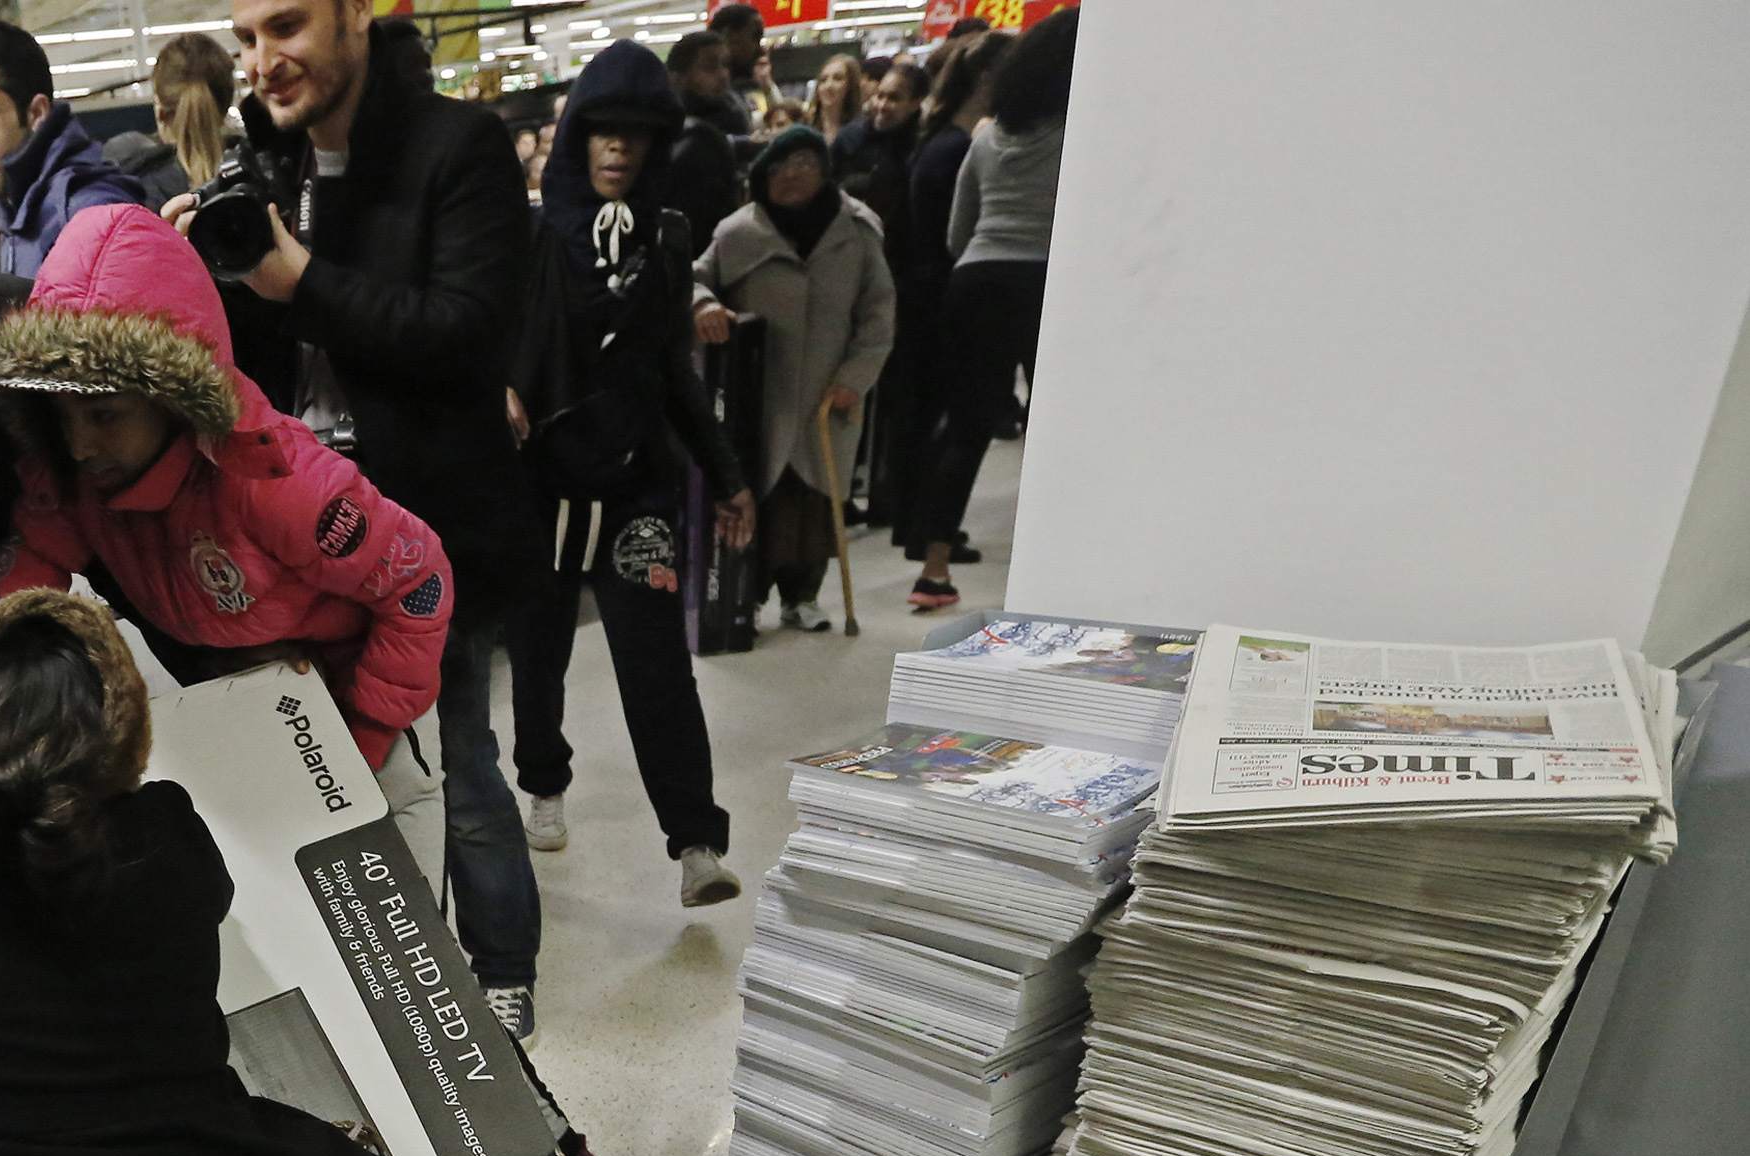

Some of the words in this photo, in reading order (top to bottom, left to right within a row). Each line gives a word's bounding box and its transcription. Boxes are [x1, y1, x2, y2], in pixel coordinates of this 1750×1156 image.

[298, 178, 313, 231] Canon
[1319, 687, 1433, 700] launched
[1320, 680, 1403, 690] targets
[1440, 691, 1618, 701] Investigation
[285, 713, 353, 813] Polaroid
[1300, 753, 1536, 781] Times
[1301, 775, 1370, 789] Kilburn
[1399, 775, 1451, 785] Brent
[313, 866, 334, 893] with
[323, 891, 355, 941] family
[348, 938, 364, 953] &
[350, 950, 385, 1001] friends
[359, 849, 397, 887] 40"
[378, 892, 420, 942] Full
[404, 942, 441, 987] HD
[426, 986, 469, 1042] LED
[457, 1041, 496, 1082] TV
[330, 859, 357, 898] Enjoy
[347, 895, 384, 954] glorious
[377, 953, 399, 982] Full
[390, 979, 412, 1007] HD
[401, 1004, 440, 1060] (1080p)
[428, 1055, 460, 1107] quality
